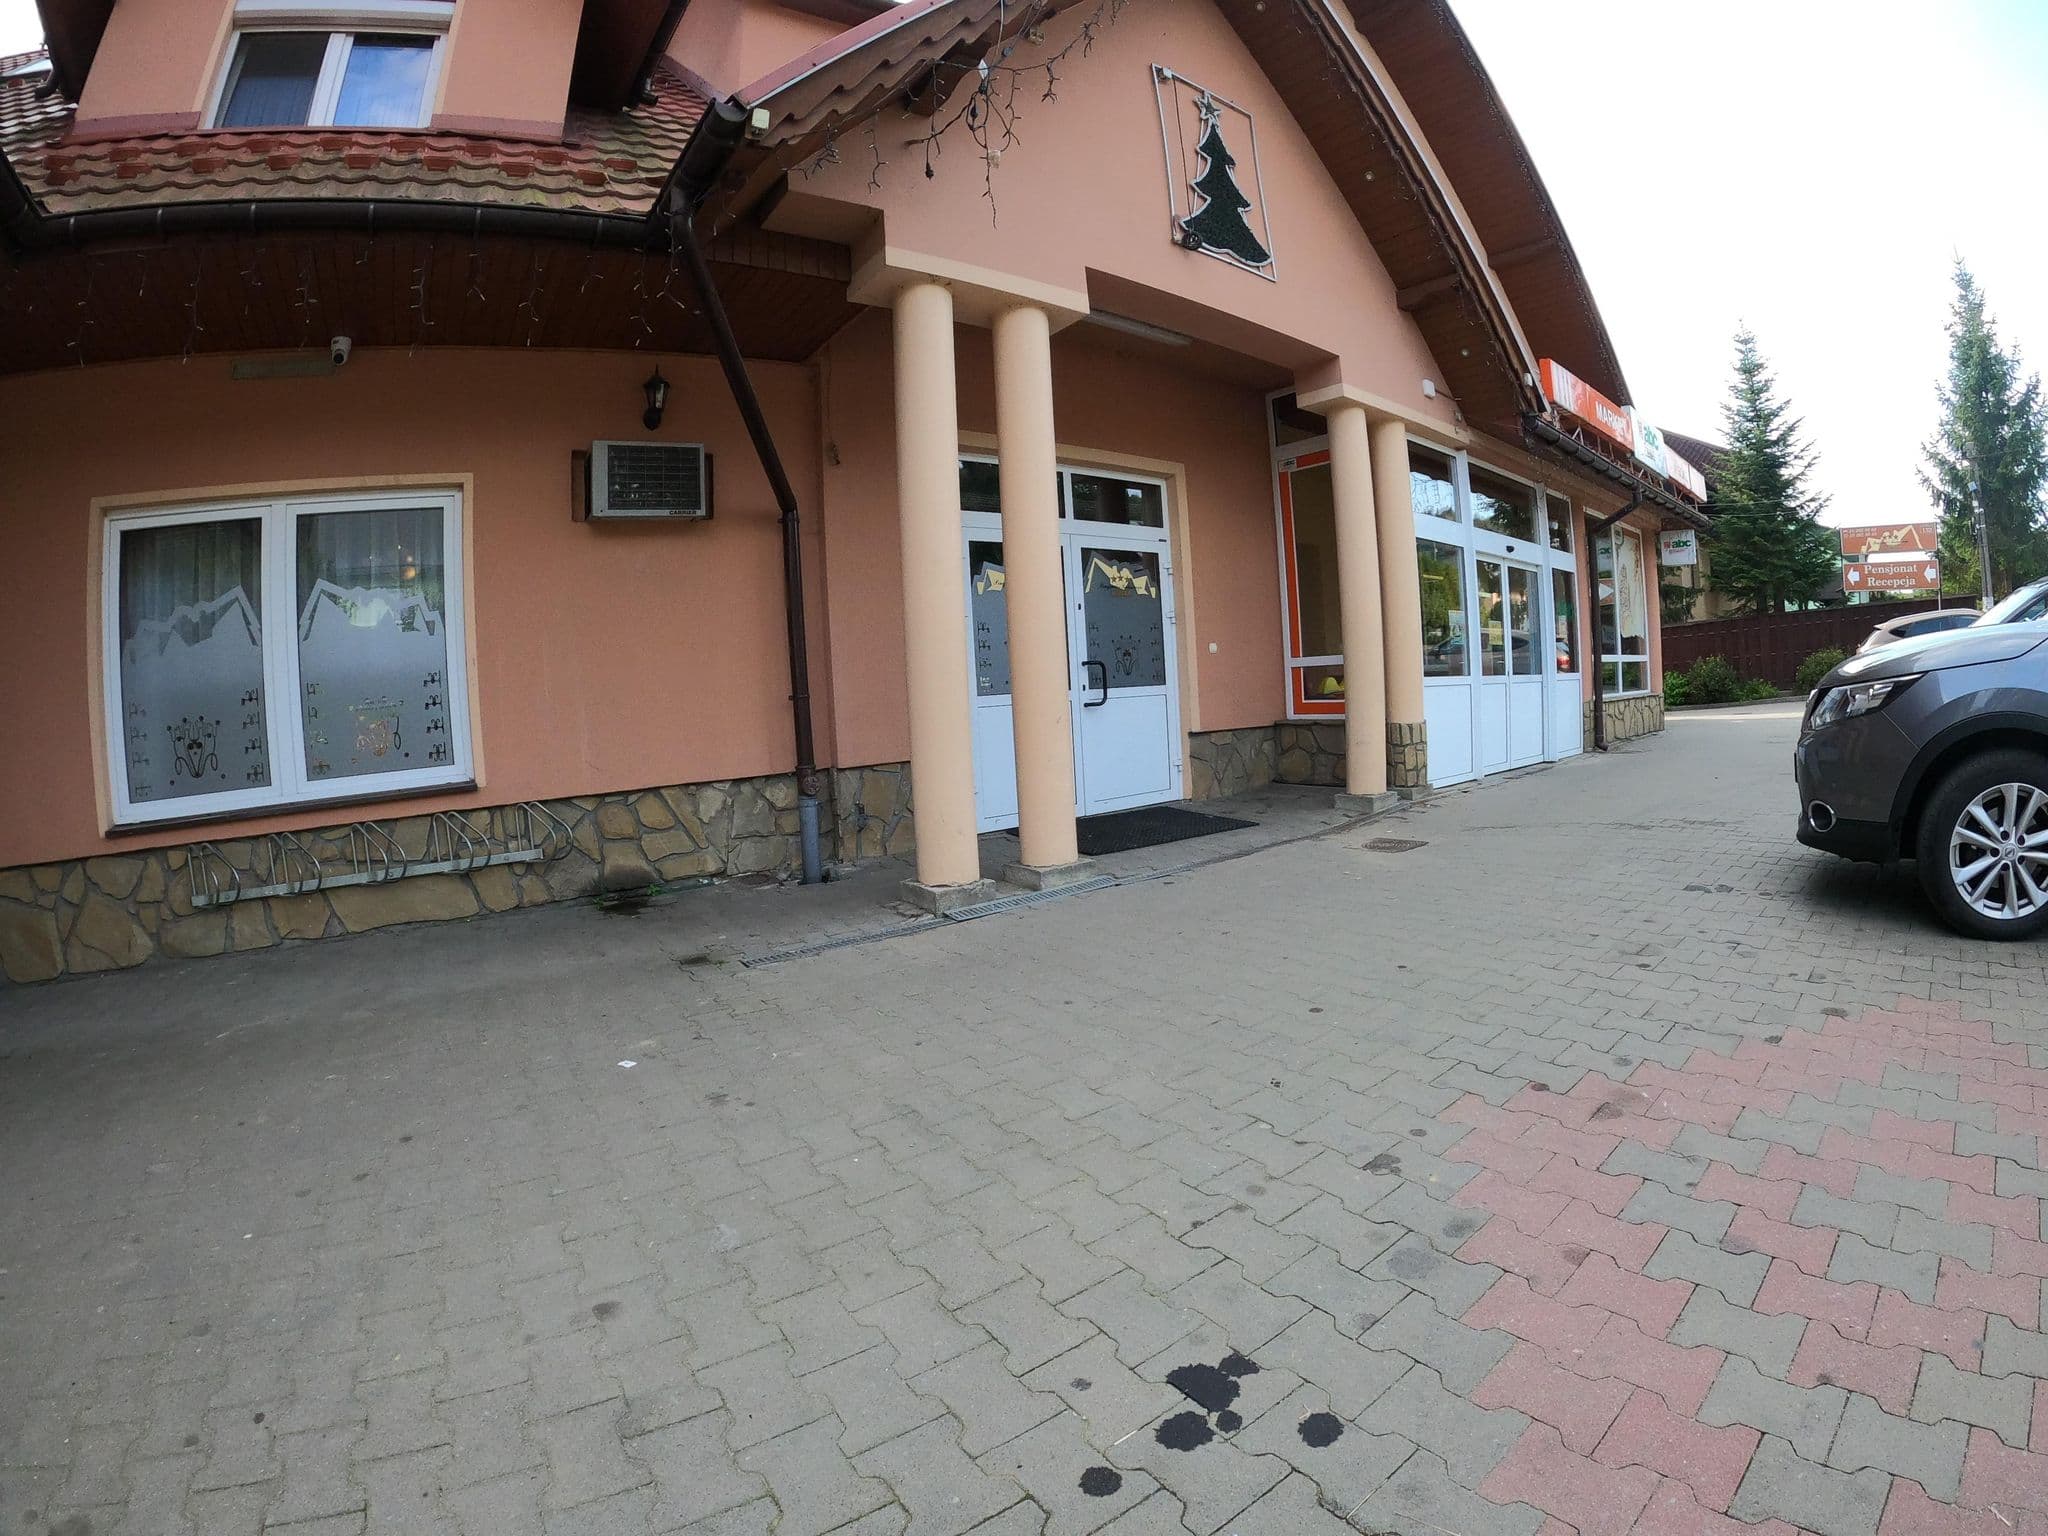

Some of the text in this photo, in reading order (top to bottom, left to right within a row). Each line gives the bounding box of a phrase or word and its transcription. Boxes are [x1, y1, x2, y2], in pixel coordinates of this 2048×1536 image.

[1672, 540, 1692, 548] abc
[1864, 564, 1918, 575] Pensjonat
[1867, 576, 1916, 588] Recepcja
